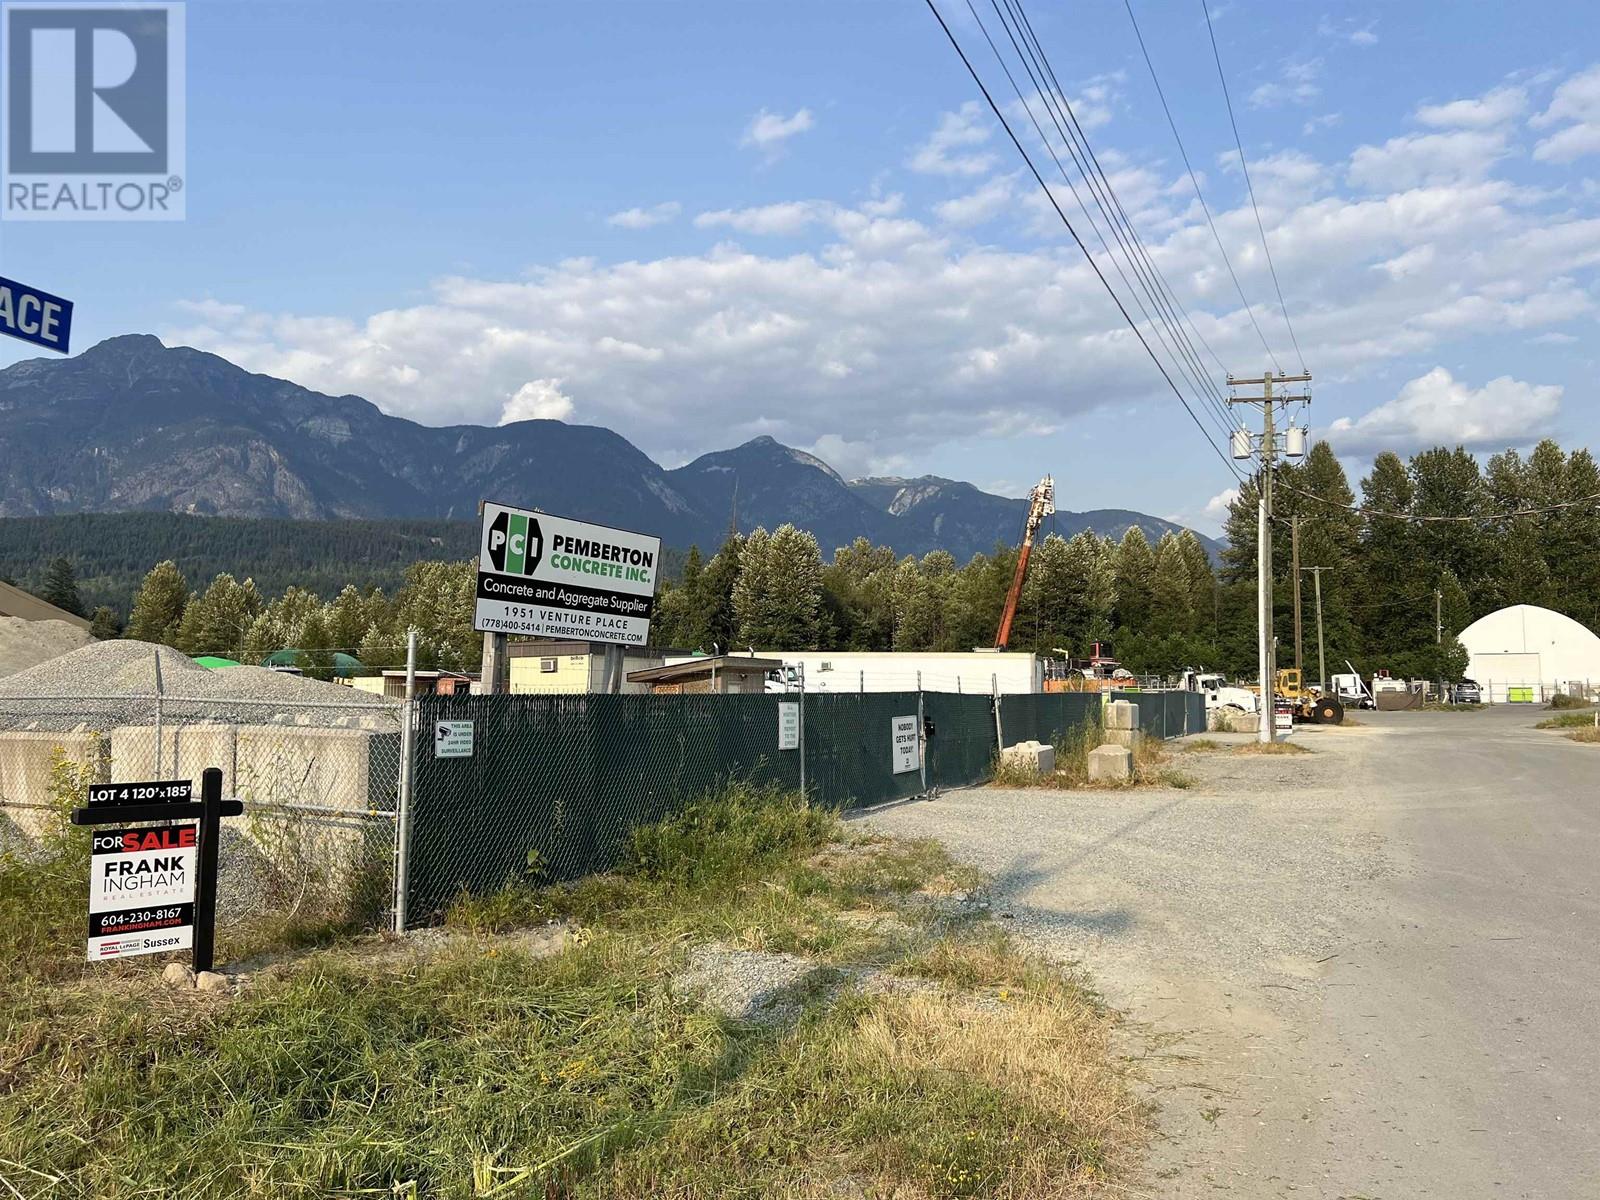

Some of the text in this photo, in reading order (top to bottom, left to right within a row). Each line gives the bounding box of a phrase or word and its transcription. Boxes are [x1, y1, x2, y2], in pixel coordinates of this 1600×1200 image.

[491, 530, 538, 557] PCI
[553, 534, 653, 568] PEMBERTON
[551, 554, 651, 583] CONCRETE INC.
[484, 578, 648, 613] Concrete and Aggregate Supplier
[504, 606, 628, 629] 1951 VENTURE PLACE
[481, 618, 643, 642] (778)400-5414 PEMBERTONCONCRETE.COM
[898, 722, 914, 731] NOBODY
[896, 735, 906, 743] GETS
[90, 789, 117, 802] LOT
[120, 789, 128, 800] 4
[94, 828, 196, 852] FOR SALE
[104, 856, 184, 877] FRANK
[104, 872, 184, 893] INGHAM
[140, 888, 184, 897] ESTATE
[101, 908, 182, 926] 604-230-8167
[102, 918, 182, 934] FRANKINGHAM.COM
[144, 937, 180, 948] Sussex
